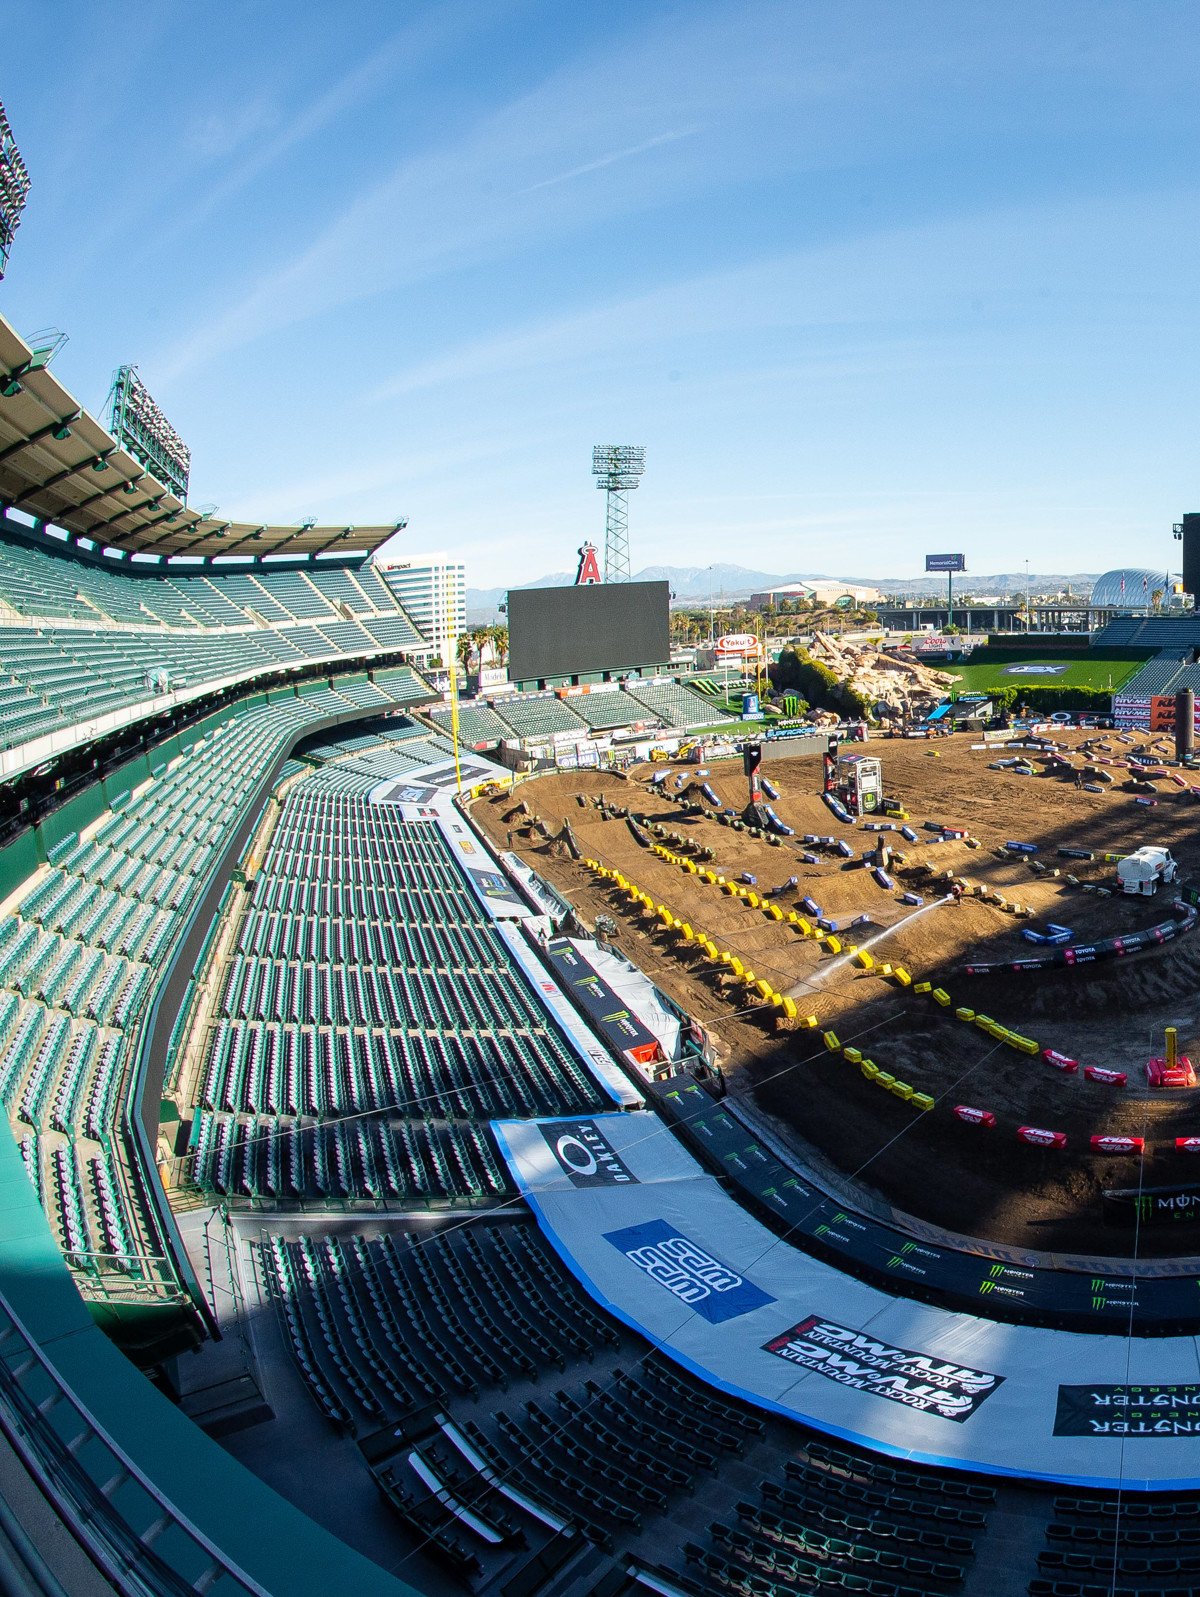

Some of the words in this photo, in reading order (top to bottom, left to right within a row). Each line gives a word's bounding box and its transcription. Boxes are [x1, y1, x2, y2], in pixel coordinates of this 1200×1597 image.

[725, 638, 752, 647] Yakut
[924, 634, 947, 645] Coors
[767, 727, 817, 738] SUPERCROSS
[590, 982, 606, 998] MONSTER
[620, 1018, 639, 1037] MONSTER
[578, 1125, 631, 1182] OAKLEY
[914, 1247, 941, 1259] MONSTER
[657, 1238, 742, 1292] WPS
[901, 1262, 927, 1275] MONSTER
[626, 1246, 711, 1303] WPS
[1004, 1268, 1034, 1279] MONSTER
[994, 1285, 1025, 1296] MONSTER
[1105, 1282, 1137, 1290] MONSTER
[803, 1330, 892, 1370] MOUNTAIN
[777, 1348, 866, 1390] MOUNTAIN
[893, 1363, 959, 1389] ROCKY
[869, 1383, 934, 1411] ROCKY
